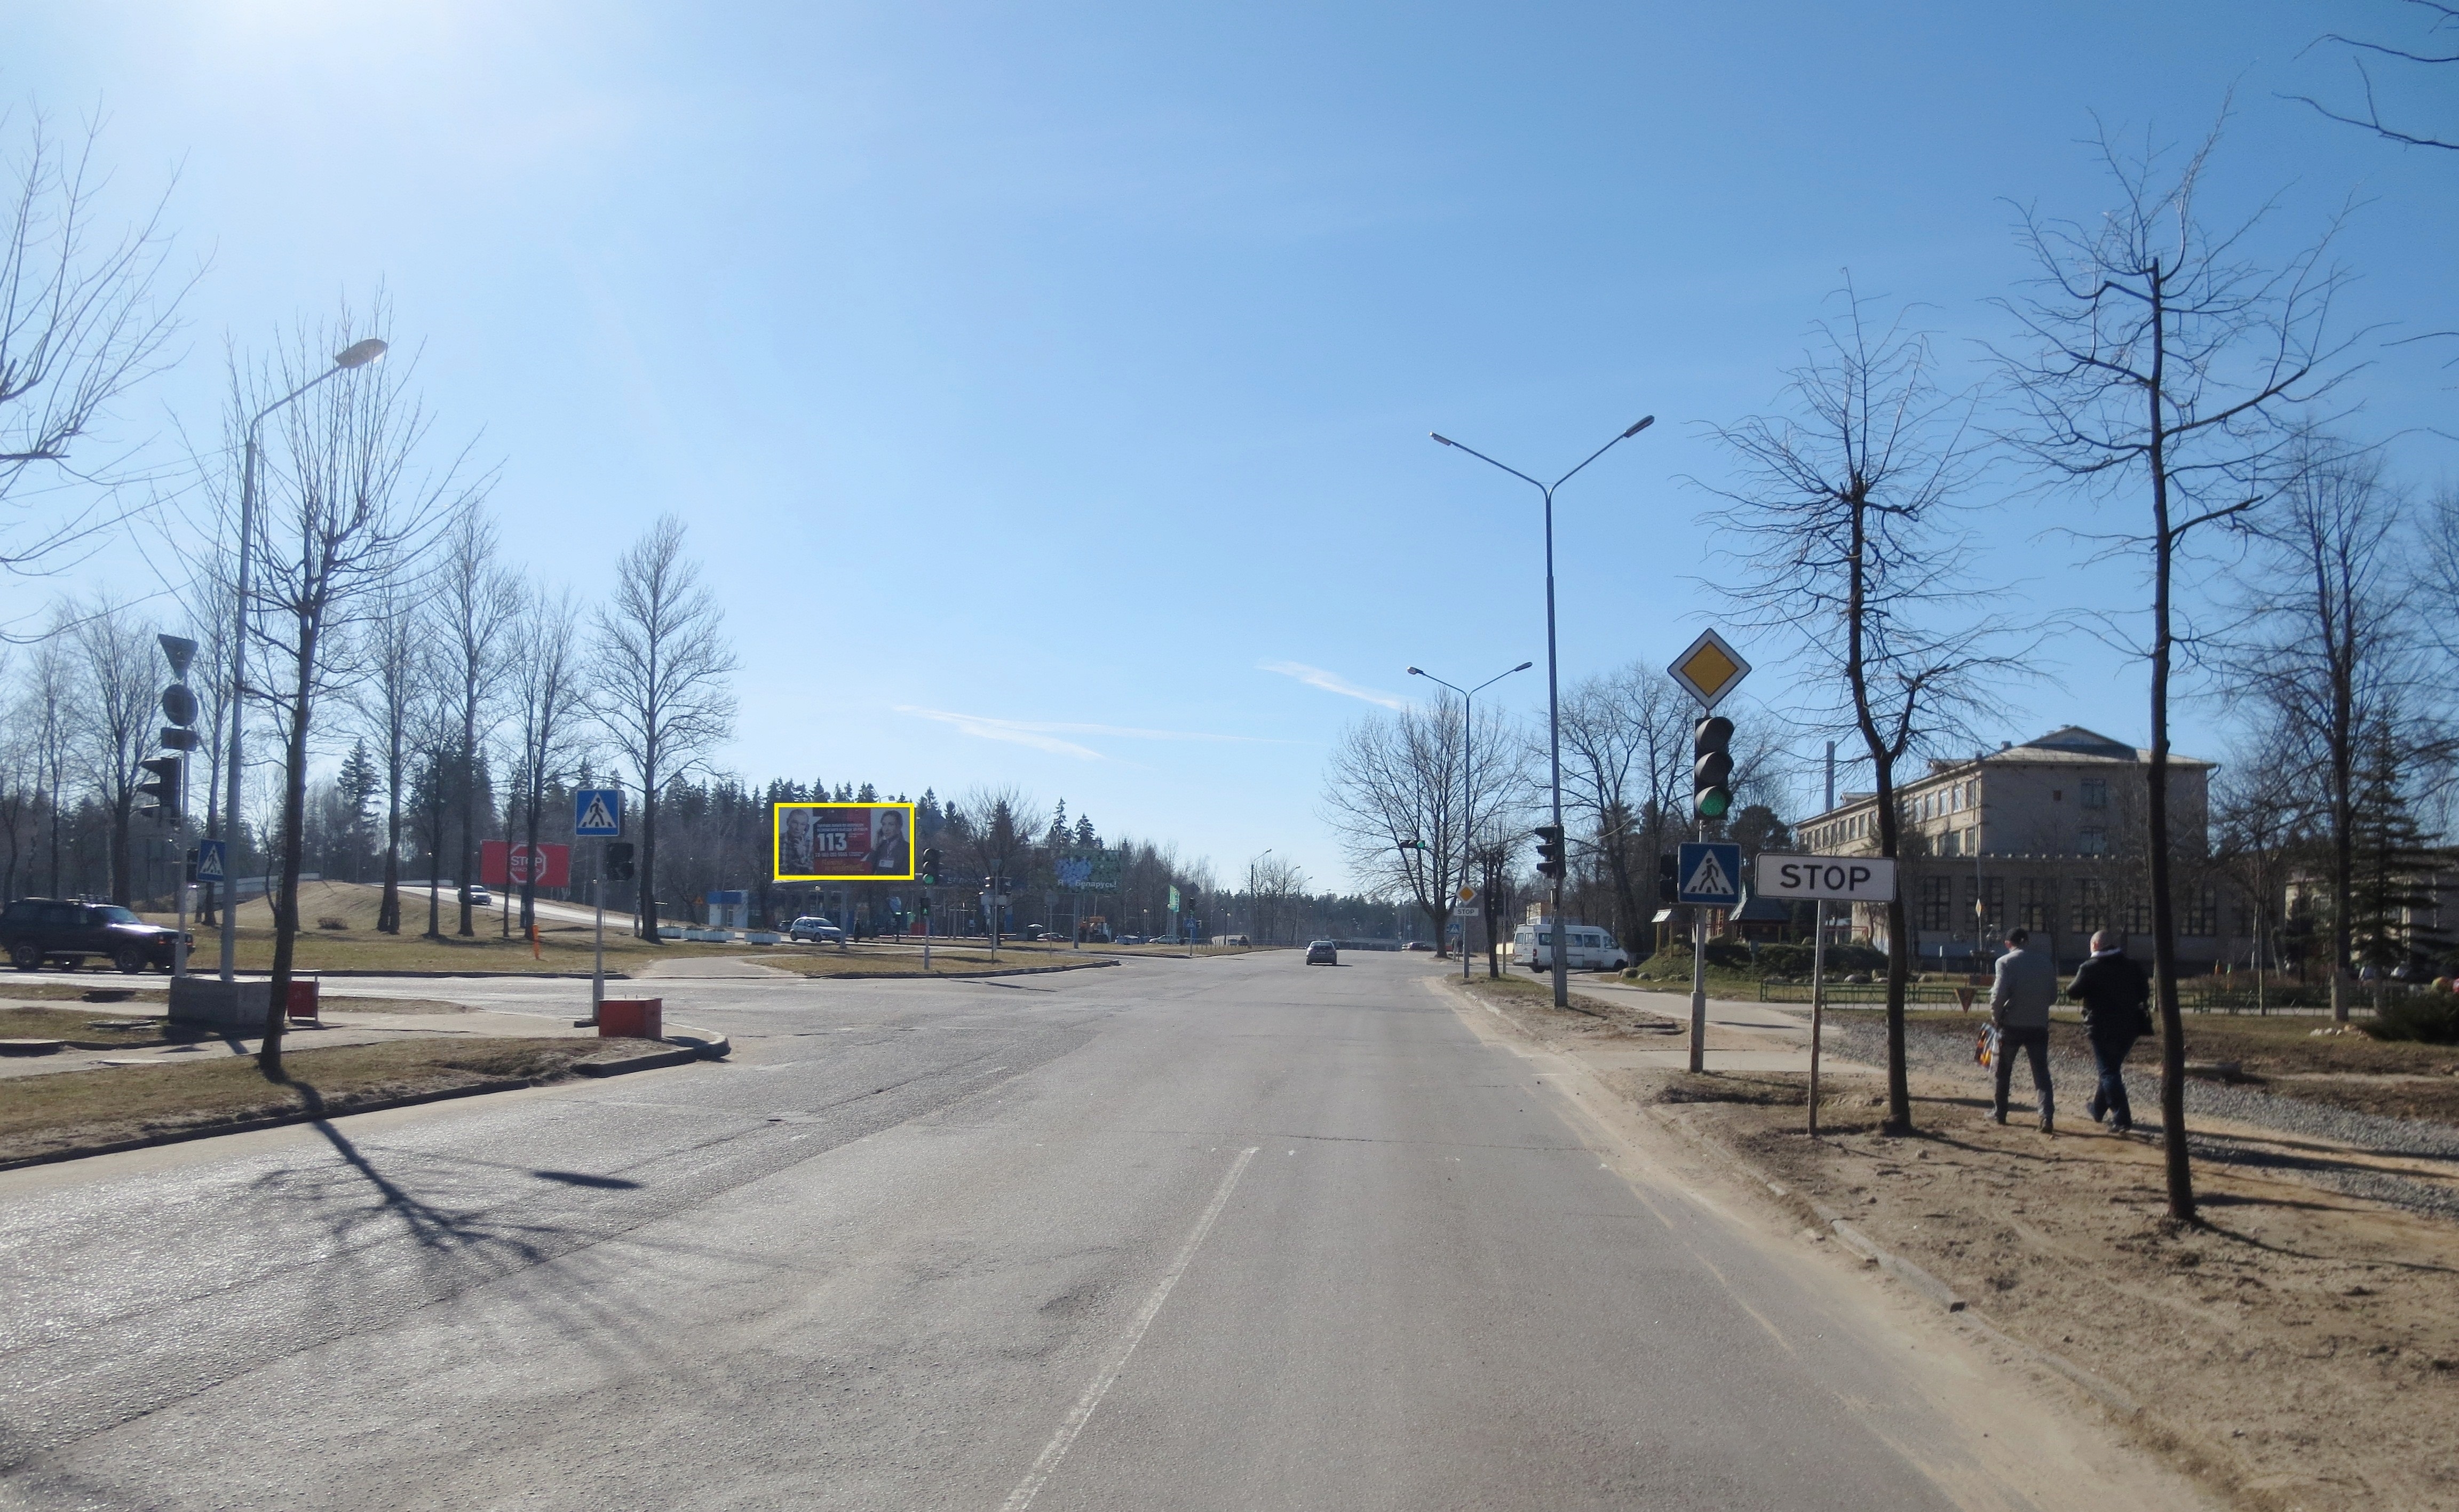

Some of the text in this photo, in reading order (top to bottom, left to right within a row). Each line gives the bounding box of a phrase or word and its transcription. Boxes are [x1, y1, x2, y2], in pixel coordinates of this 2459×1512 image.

[817, 833, 847, 851] 113
[1075, 880, 1116, 888] Беларусь!
[1780, 864, 1871, 891] STOP
